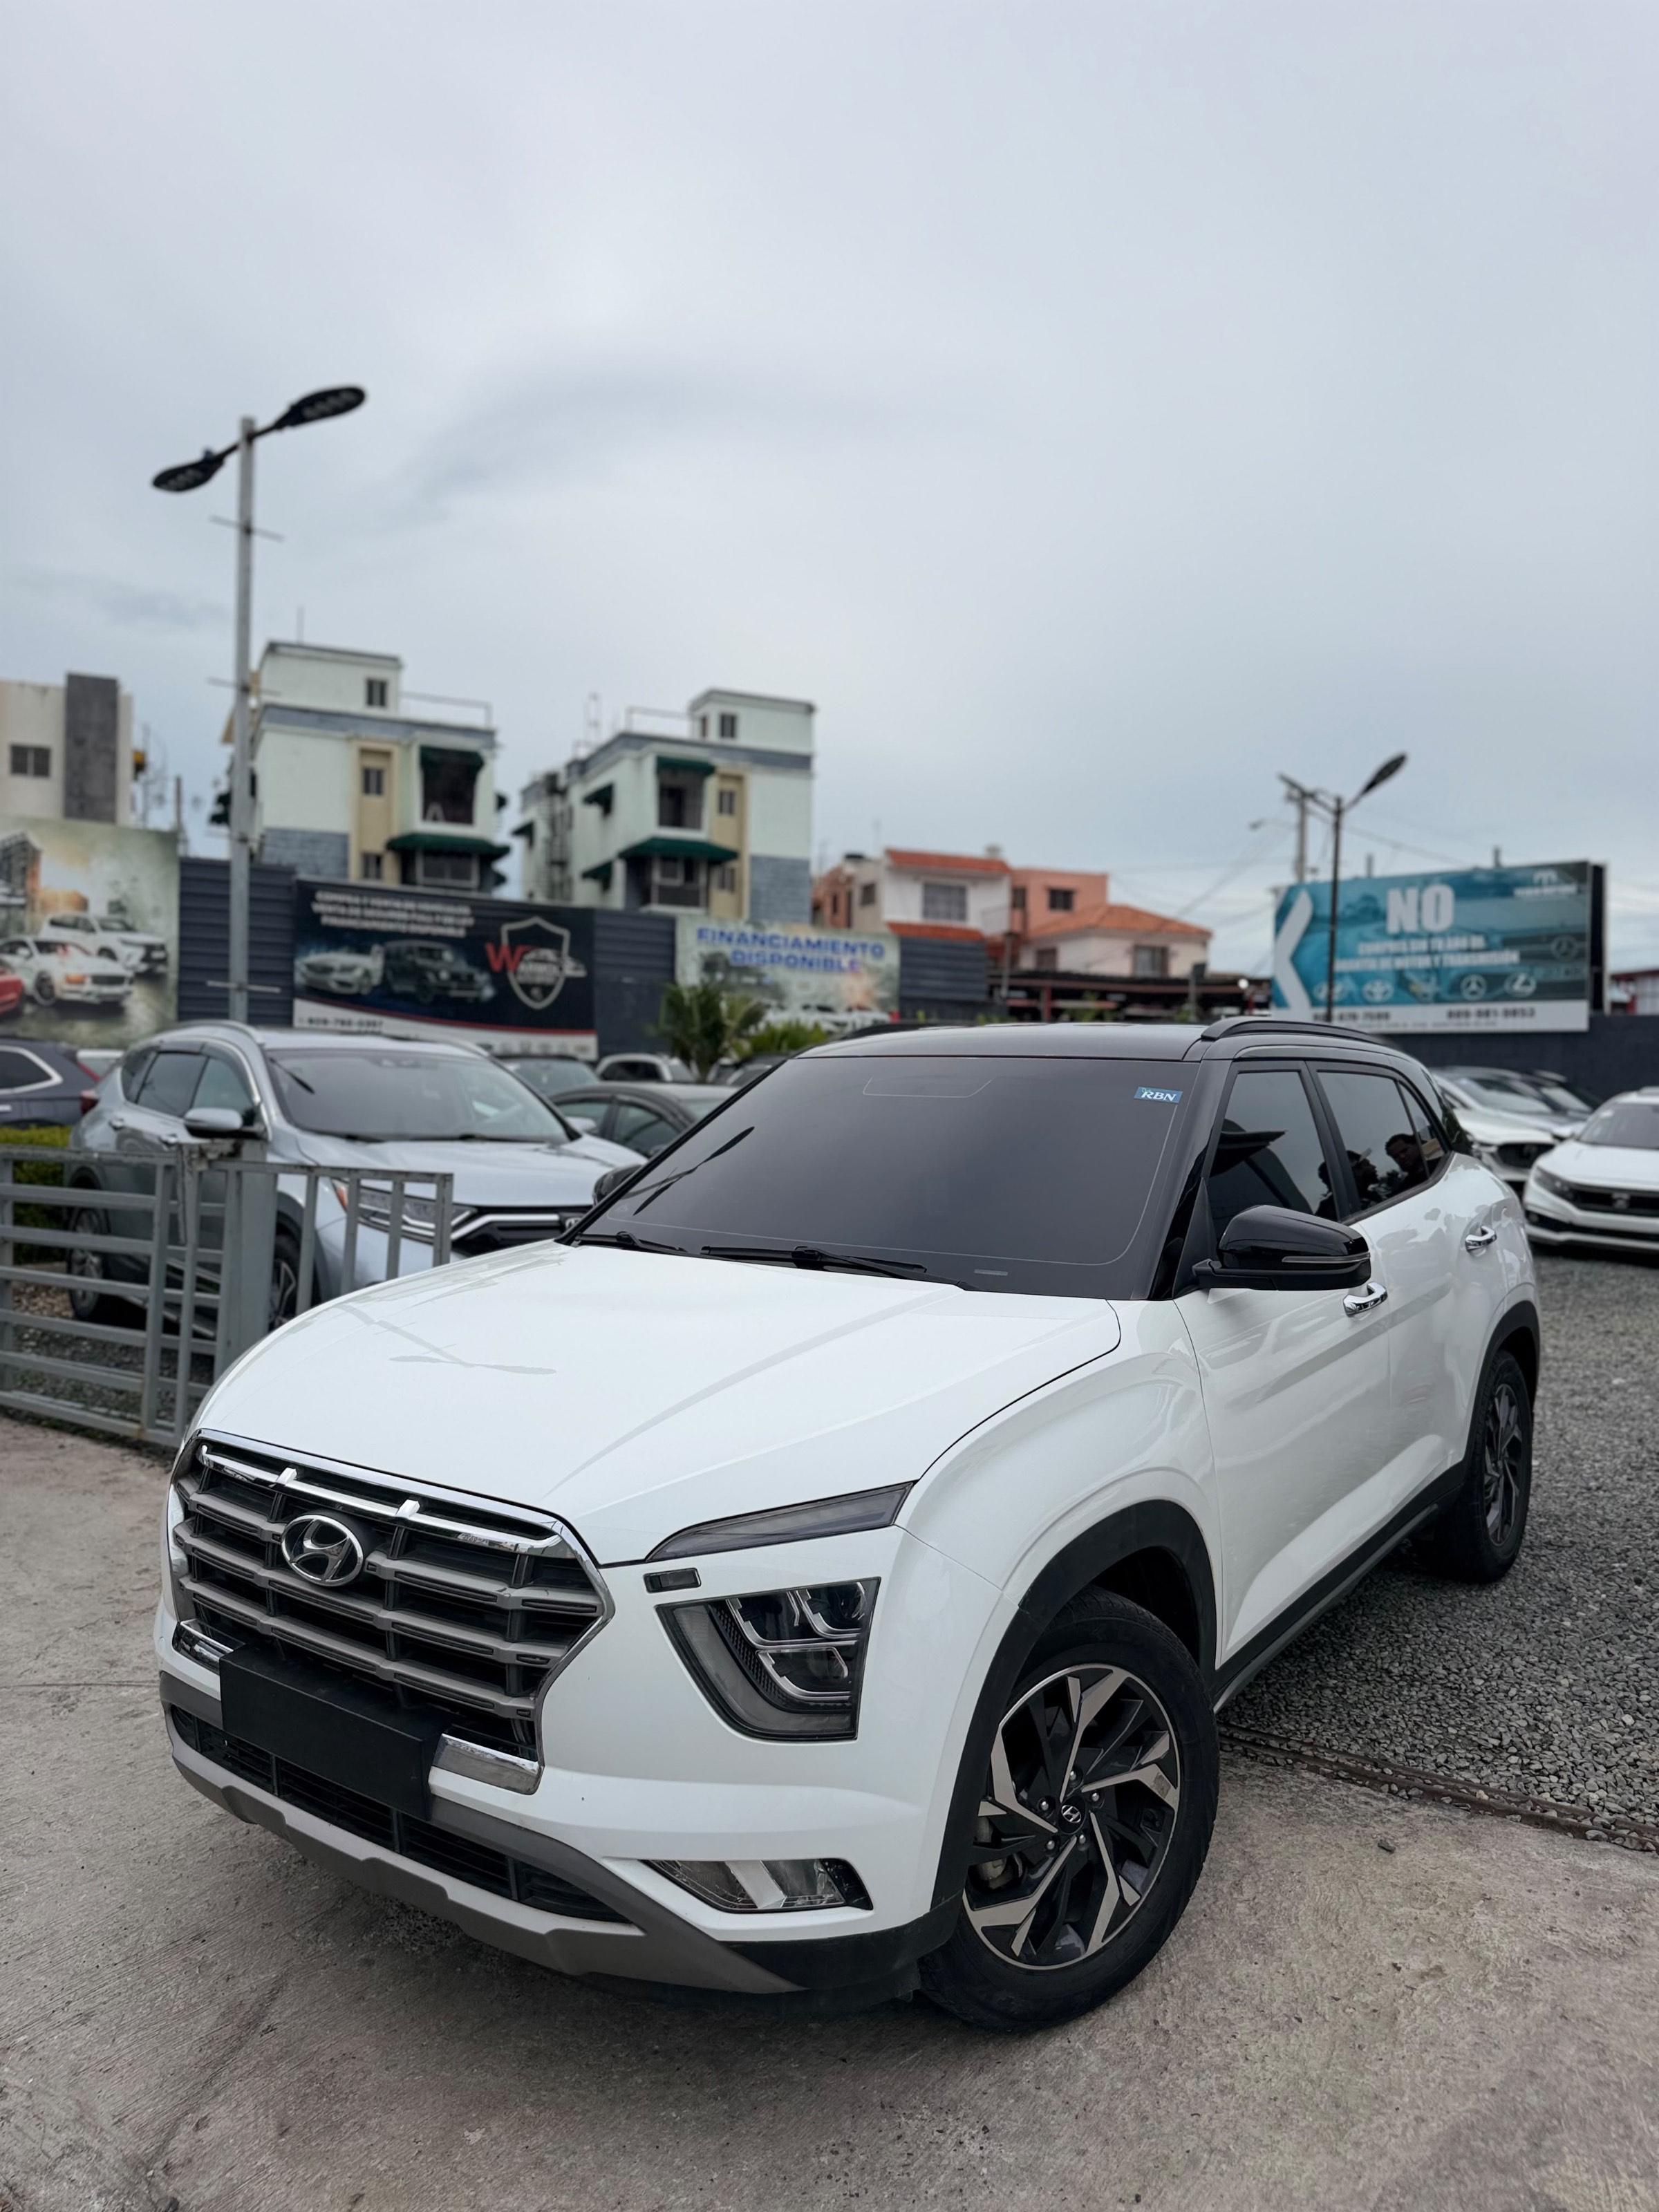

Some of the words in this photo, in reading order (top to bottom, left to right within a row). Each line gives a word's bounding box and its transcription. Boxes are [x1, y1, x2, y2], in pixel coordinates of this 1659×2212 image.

[1388, 885, 1455, 934] NO
[697, 927, 885, 959] FINANCIAMIENTO
[731, 949, 861, 973] DISPONIBLE
[1141, 1091, 1177, 1101] RBN
